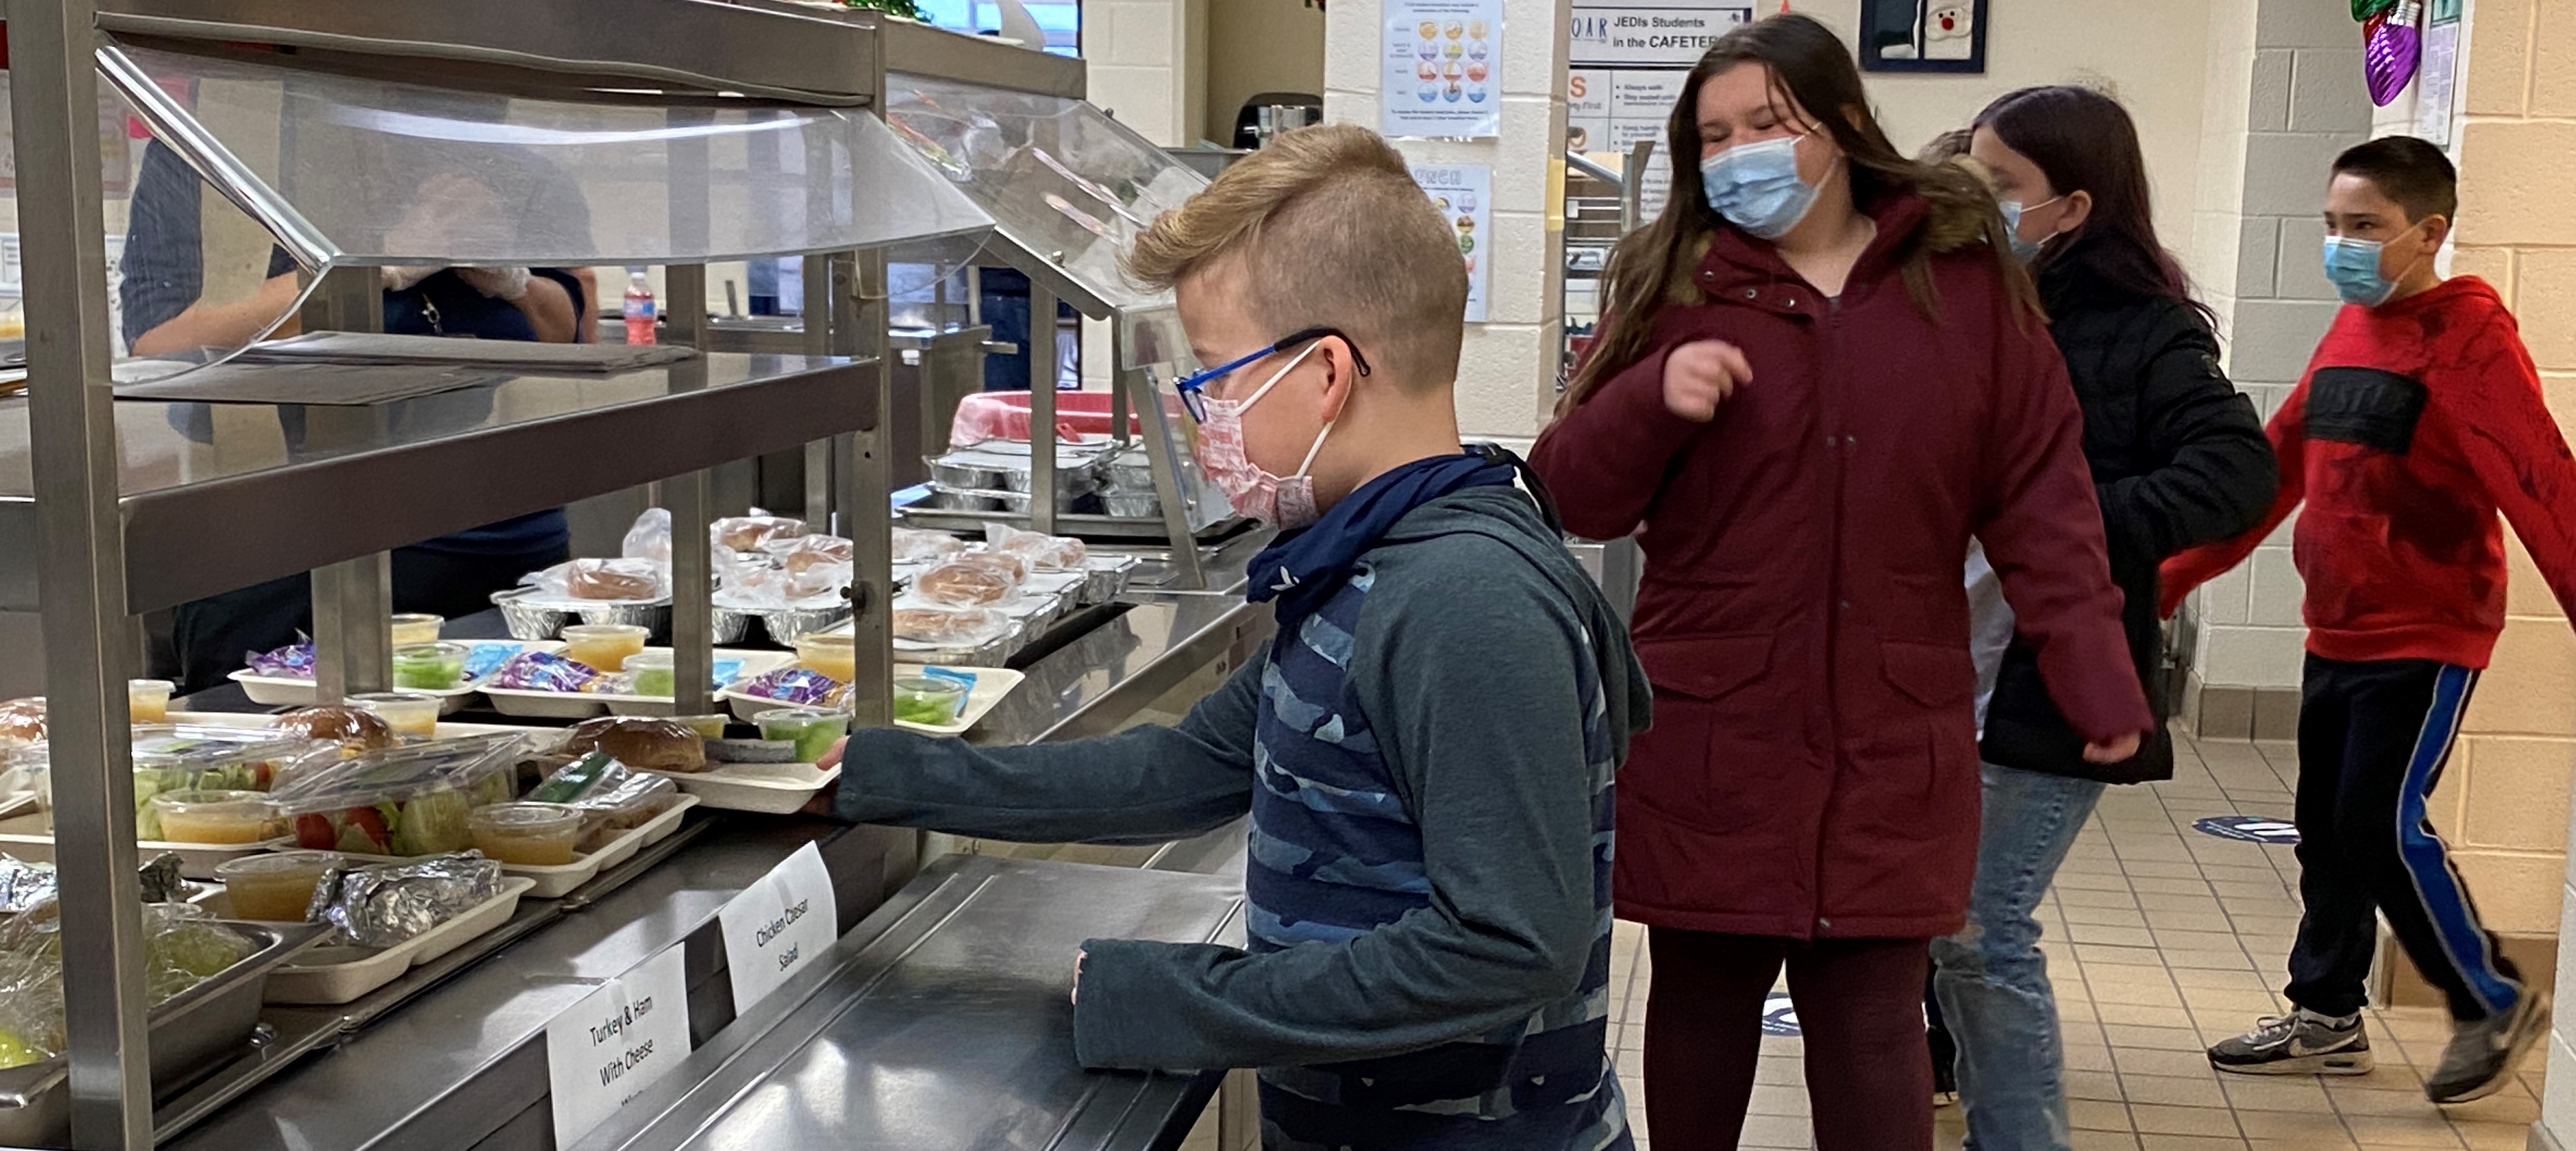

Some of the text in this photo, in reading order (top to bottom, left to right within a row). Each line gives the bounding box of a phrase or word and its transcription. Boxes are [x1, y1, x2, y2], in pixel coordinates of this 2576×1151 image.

[1571, 17, 1607, 38] OAR
[1614, 17, 1705, 28] JEDIs Students
[1613, 37, 1624, 47] in
[1627, 37, 1645, 47] the
[1650, 36, 1719, 48] CAFETER
[1570, 76, 1587, 98] S
[756, 898, 808, 948] Chicken Caesar
[779, 942, 798, 972] Salad
[590, 996, 652, 1047] Turkey & Ham
[599, 1039, 653, 1087] With Cheese
